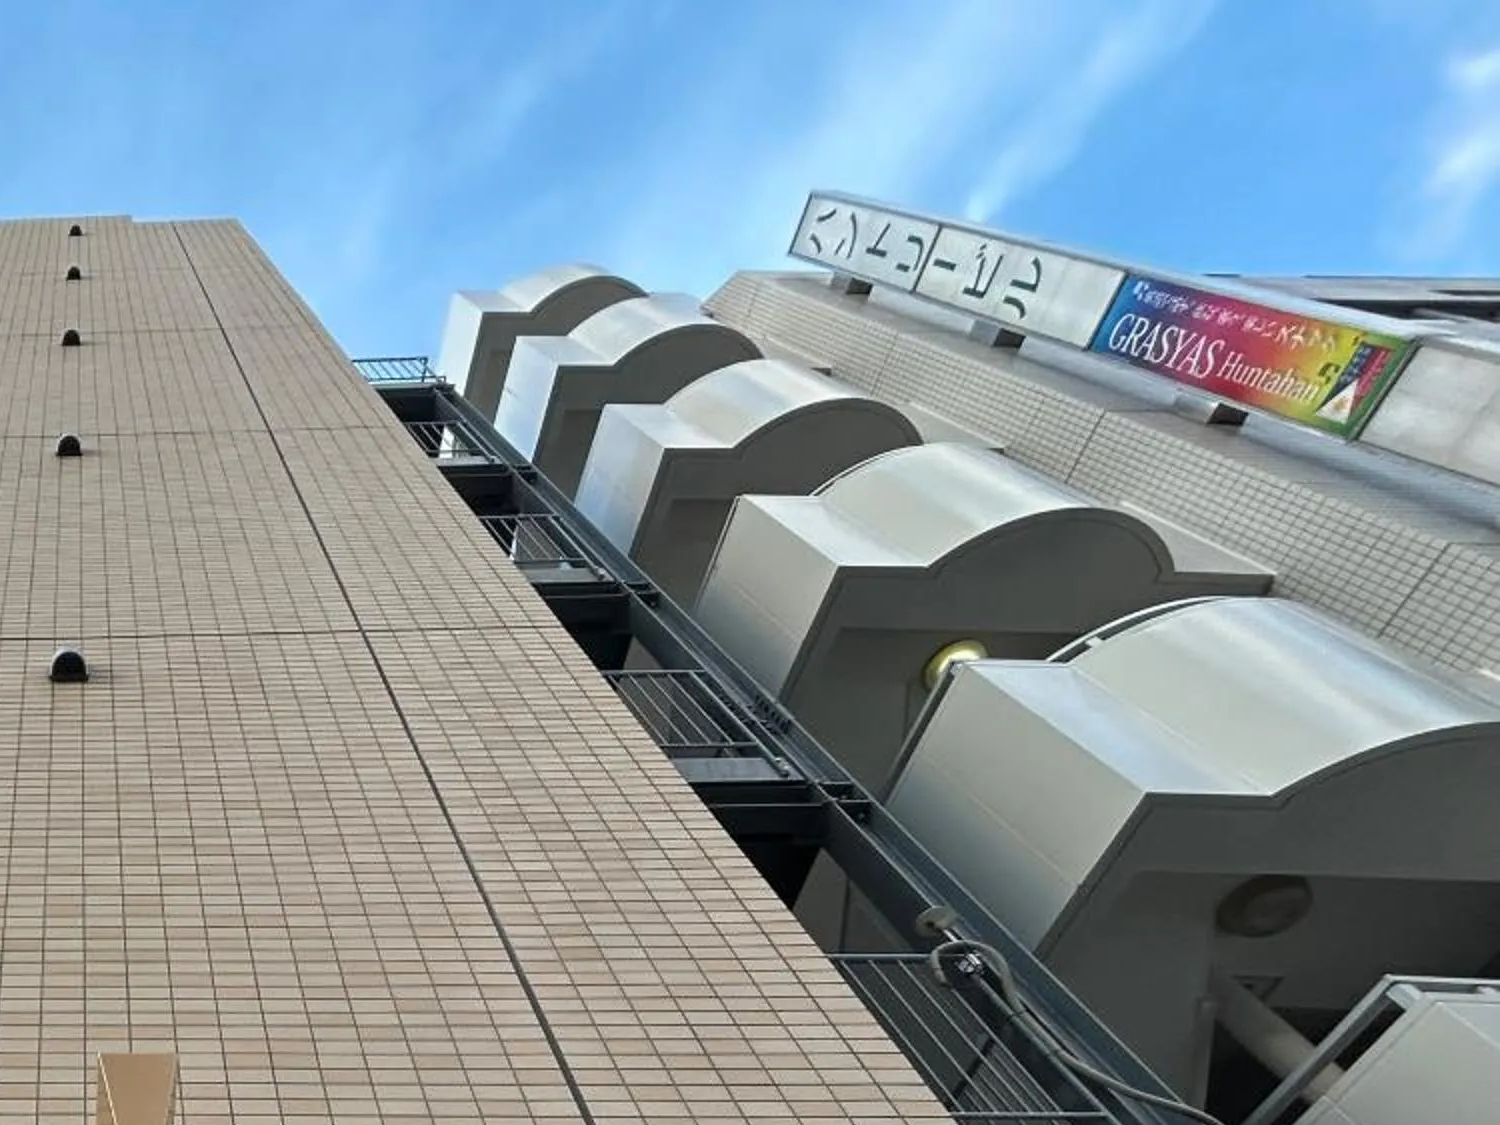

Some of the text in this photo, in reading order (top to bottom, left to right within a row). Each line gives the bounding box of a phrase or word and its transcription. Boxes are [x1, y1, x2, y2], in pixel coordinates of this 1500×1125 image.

[809, 207, 1041, 320] ハントリービル
[1109, 313, 1225, 379] GRASYAS
[1216, 350, 1321, 402] Huntahan
